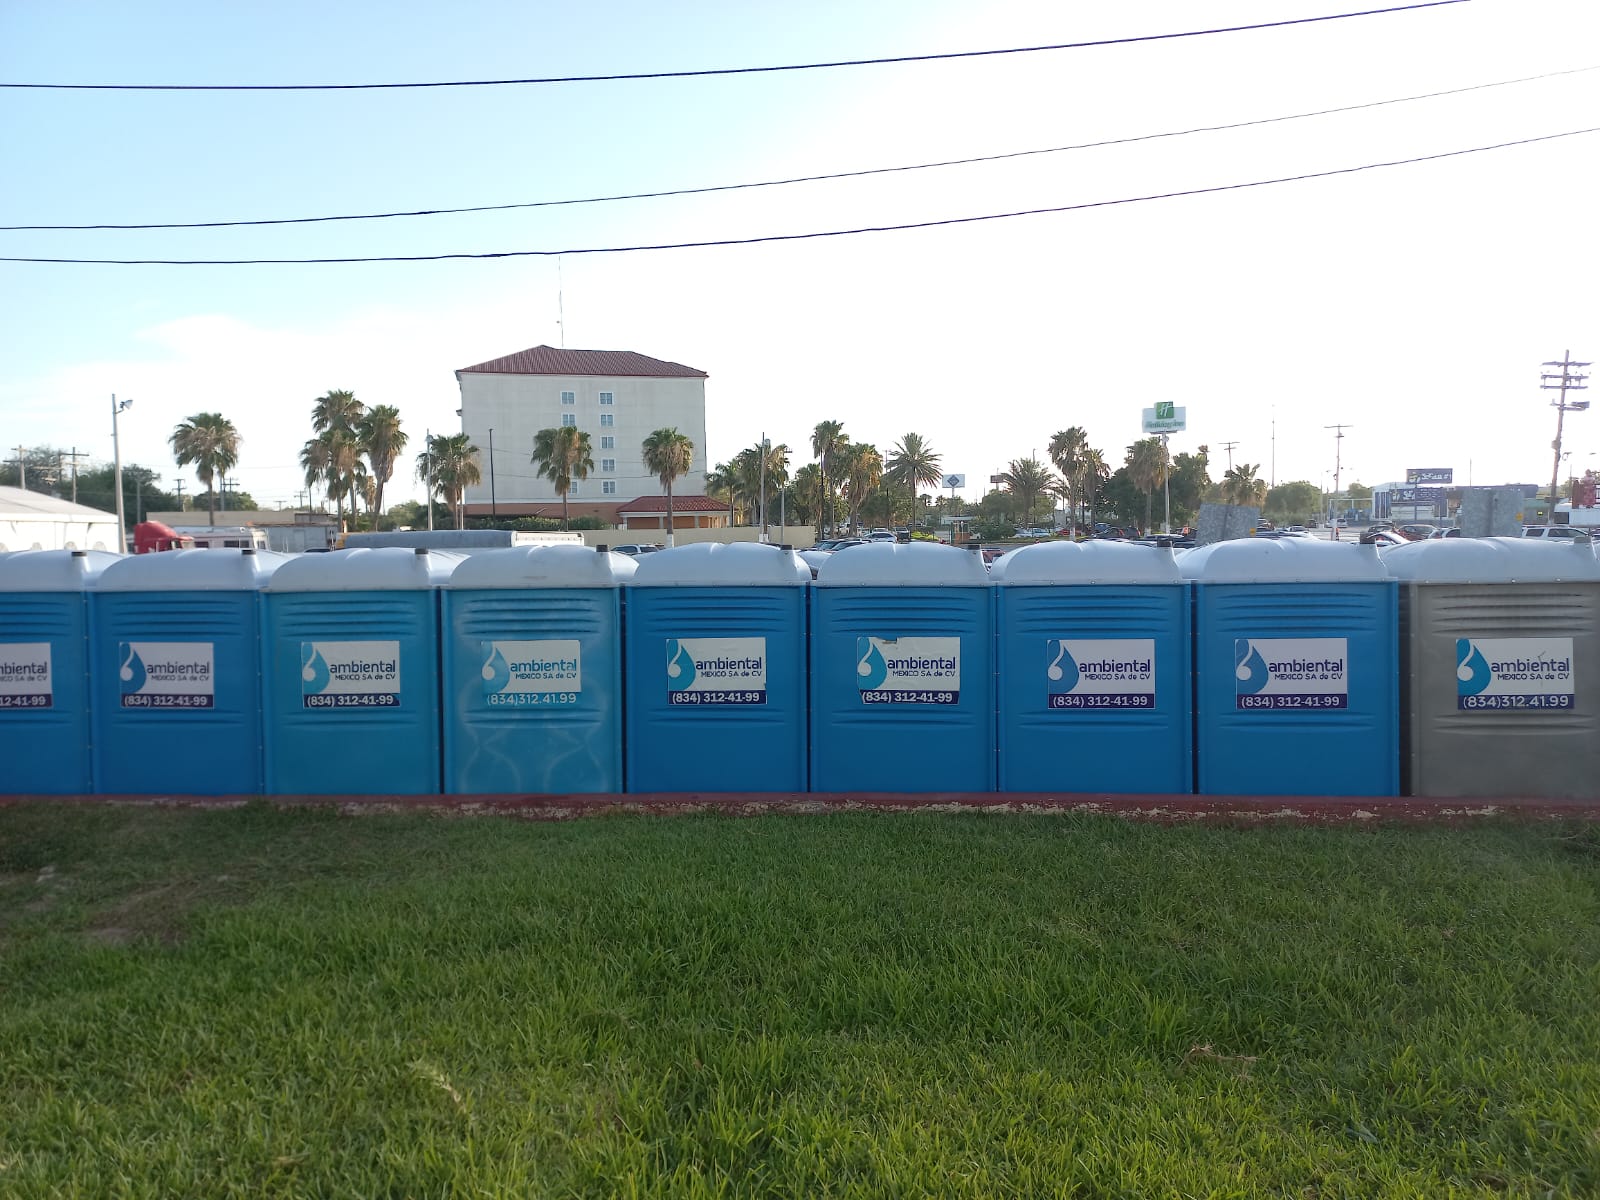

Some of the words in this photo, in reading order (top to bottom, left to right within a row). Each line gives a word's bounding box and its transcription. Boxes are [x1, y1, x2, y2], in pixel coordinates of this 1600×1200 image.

[0, 662, 47, 674] biental
[146, 662, 210, 674] ambiental
[330, 660, 396, 674] ambiental
[510, 659, 577, 673] ambiental
[696, 657, 762, 670] ambiental
[887, 657, 956, 670] ambiental
[1079, 659, 1151, 672] ambiental
[1268, 658, 1343, 672] ambiental
[1491, 658, 1570, 672] ambiental
[0, 696, 46, 706] 12-41-99
[124, 696, 151, 706] (834)
[154, 696, 207, 706] 312-41-99
[307, 696, 335, 707] (834)
[337, 696, 394, 706] 312-41-99
[672, 692, 700, 704] (834)
[703, 692, 759, 702] 312-41-99
[862, 692, 892, 703] (834)
[895, 692, 953, 703] 312-41-99
[1053, 696, 1085, 707] (834)
[1087, 696, 1148, 706] 312-41-99
[1241, 696, 1274, 708] (834)
[1277, 696, 1340, 706] 312-41-99
